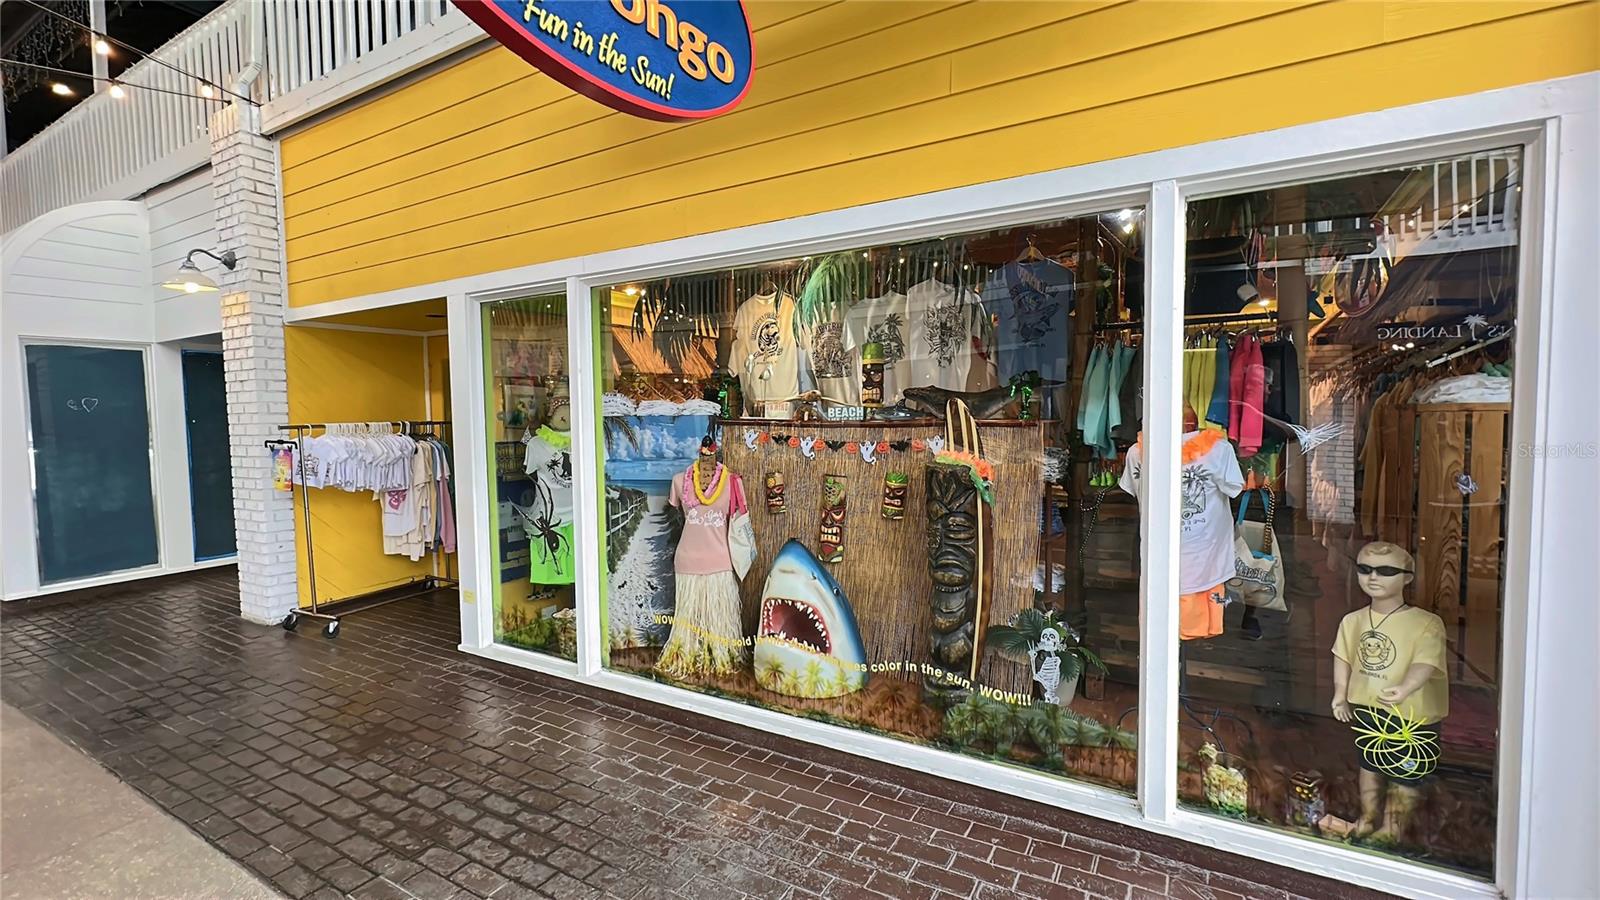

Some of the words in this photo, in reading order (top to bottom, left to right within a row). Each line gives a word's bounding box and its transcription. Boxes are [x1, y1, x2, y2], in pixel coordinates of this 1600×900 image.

[520, 0, 569, 41] Fun
[572, 21, 594, 56] in
[598, 32, 627, 73] the
[631, 55, 675, 100] Sun!
[827, 407, 864, 417] BEACH
[871, 660, 902, 673] color
[905, 660, 917, 672] in
[921, 663, 942, 678] the
[979, 684, 1032, 706] WOW!!!
